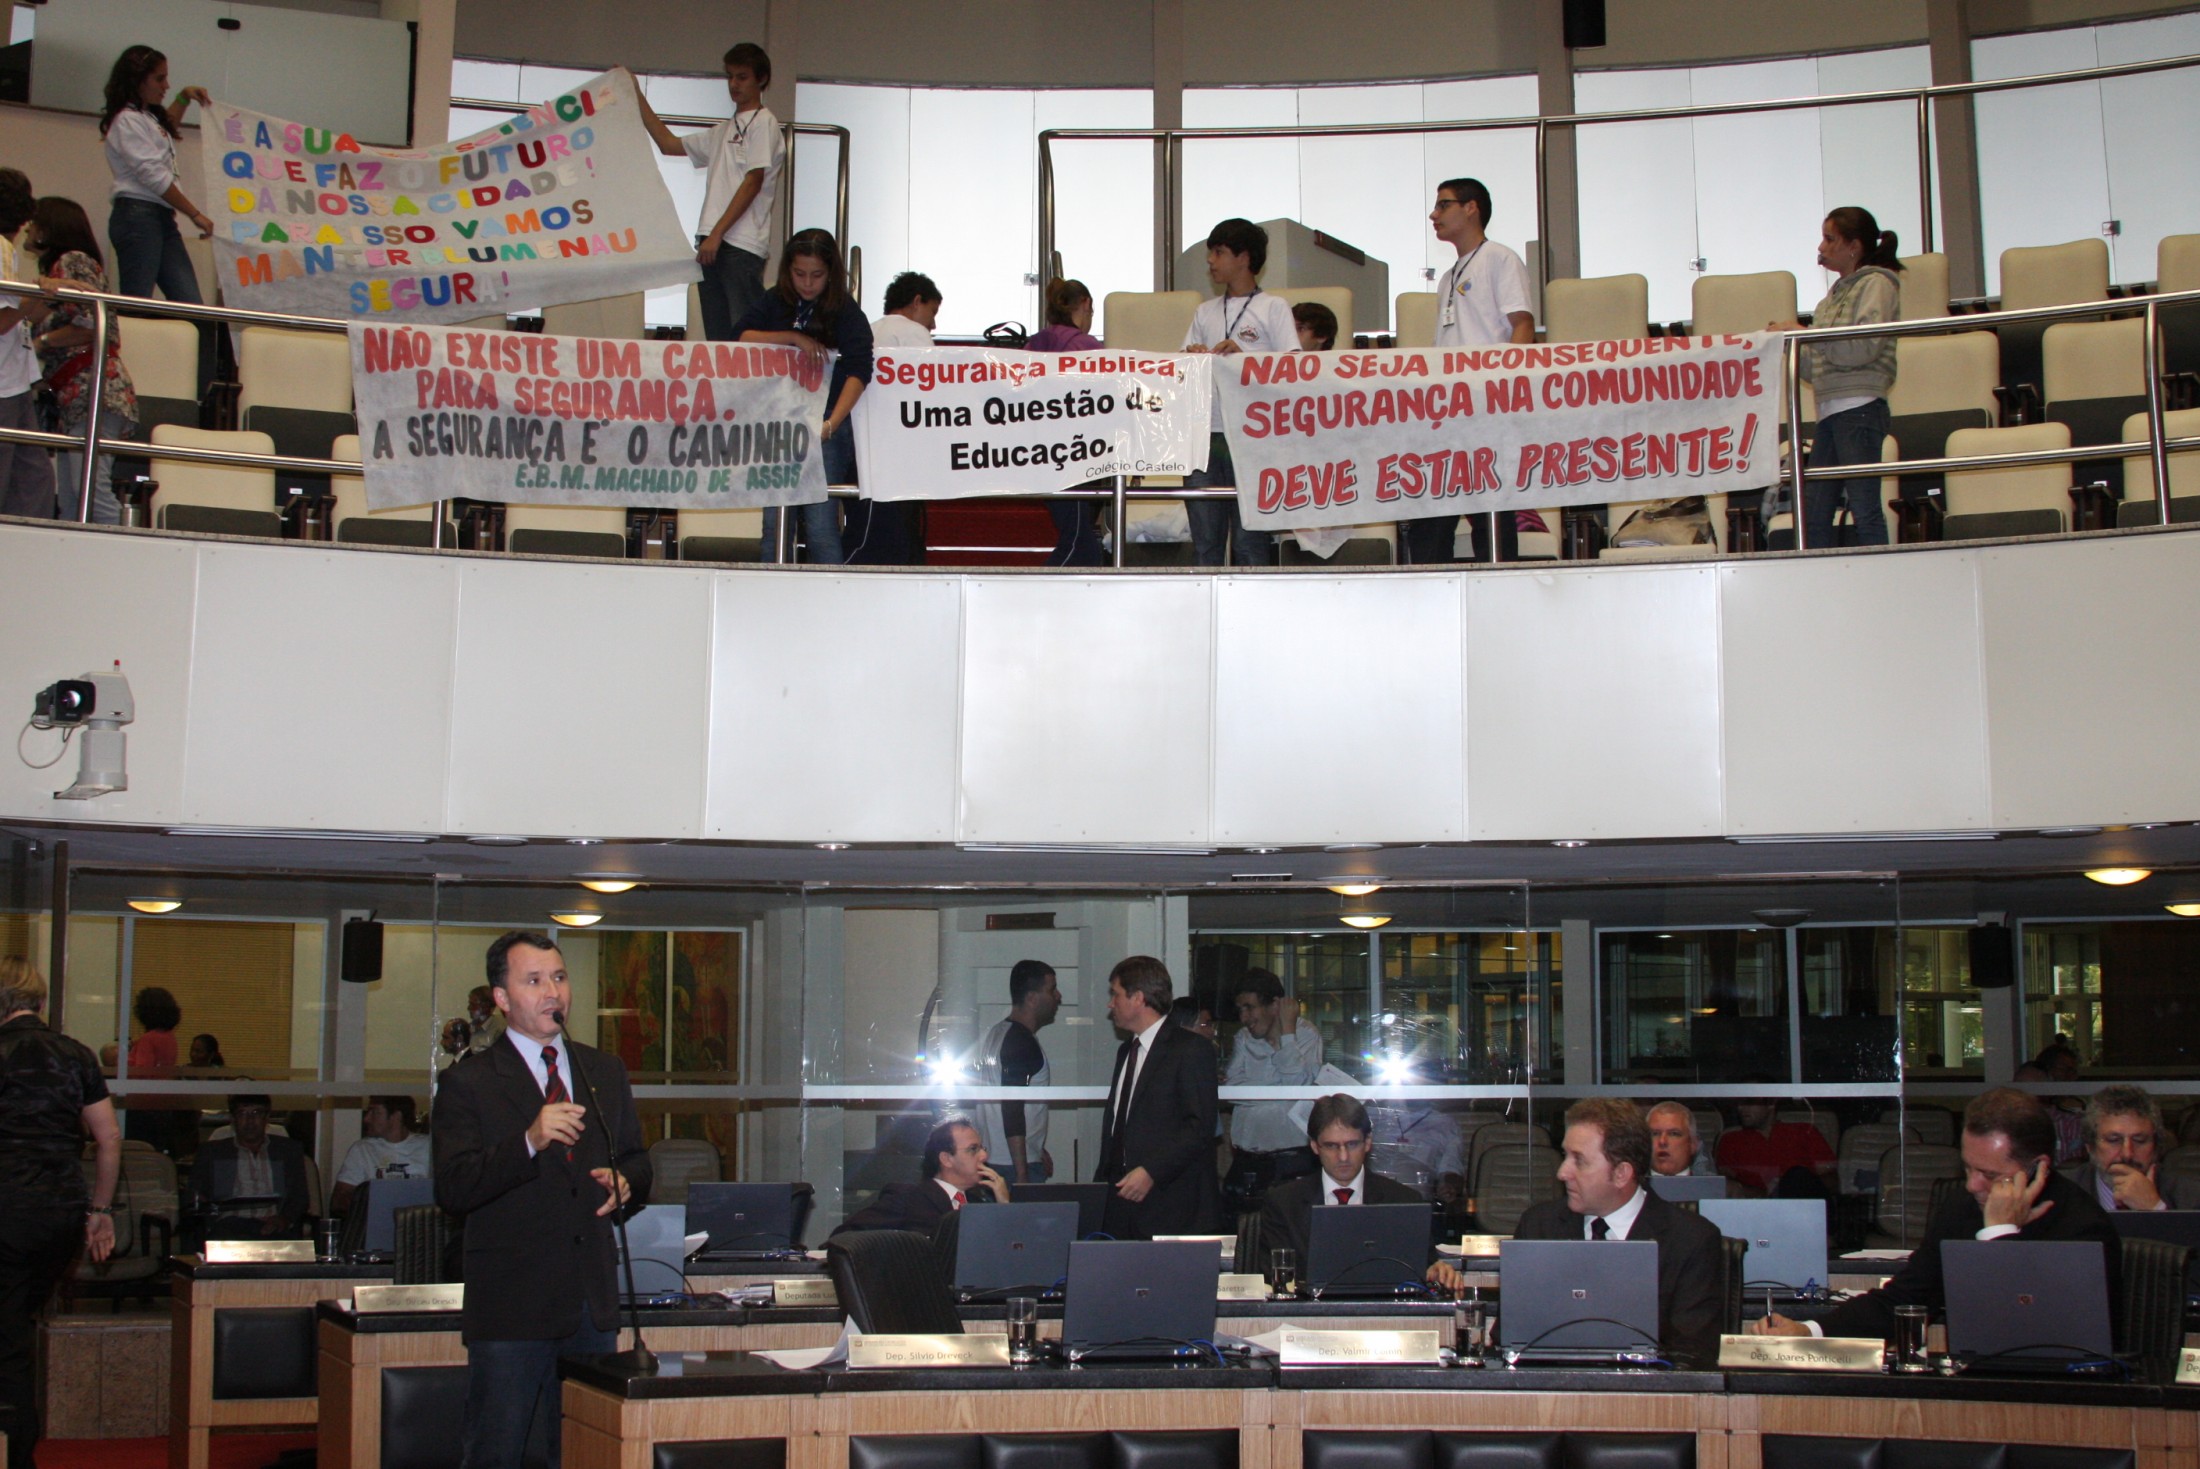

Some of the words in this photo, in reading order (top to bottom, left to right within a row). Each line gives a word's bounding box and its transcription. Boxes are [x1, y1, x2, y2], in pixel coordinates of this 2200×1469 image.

[222, 151, 307, 182] QUE
[315, 161, 385, 190] FAZ
[399, 162, 425, 190] O
[439, 126, 594, 185] FUTURO
[255, 121, 272, 149] A
[283, 123, 361, 155] SUA
[227, 186, 277, 214] DA
[286, 188, 420, 216] NOSSA
[428, 157, 596, 213] CIDADE!
[232, 222, 344, 245] PARA
[452, 199, 594, 239] VAMOS
[237, 245, 412, 287] MANTER
[421, 227, 637, 265] BLUMENAU
[350, 271, 509, 314] SEGURA!
[363, 326, 432, 374] NÃO
[447, 332, 560, 377] EXISTE
[576, 339, 641, 379] UM
[1241, 352, 1320, 386] NÃO
[1334, 354, 1429, 379] SEJA
[876, 356, 1046, 392] Segurança
[416, 367, 499, 410] PARA
[514, 376, 735, 426] SEGURANÇA.
[899, 401, 971, 429] Uma
[983, 389, 1114, 426] Questão
[1125, 388, 1163, 413] de
[1242, 381, 1473, 439] SEGURANÇA
[1485, 378, 1534, 414] NA
[1542, 356, 1763, 410] COMUNIDADE
[373, 419, 394, 460] A
[407, 412, 566, 468] SEGURANÇA
[627, 425, 648, 465] O
[669, 420, 810, 468] CAMINHO
[950, 434, 1114, 471] Educação.
[594, 466, 698, 493] MACHADO
[708, 469, 732, 494] DE
[747, 463, 802, 491] ASSIS
[1085, 460, 1131, 478] Colégio
[1135, 459, 1185, 473] Castelo
[1257, 458, 1358, 514] DEVE
[1375, 447, 1502, 502] ESTAR
[1516, 413, 1759, 491] PRESENTE!
[885, 1352, 906, 1361] Dep.
[910, 1351, 935, 1360] Silvio
[1319, 1347, 1339, 1357] Dep.
[1751, 1352, 1771, 1362] Dep.
[1775, 1352, 1805, 1362] Joares
[2186, 1363, 2200, 1374] De
